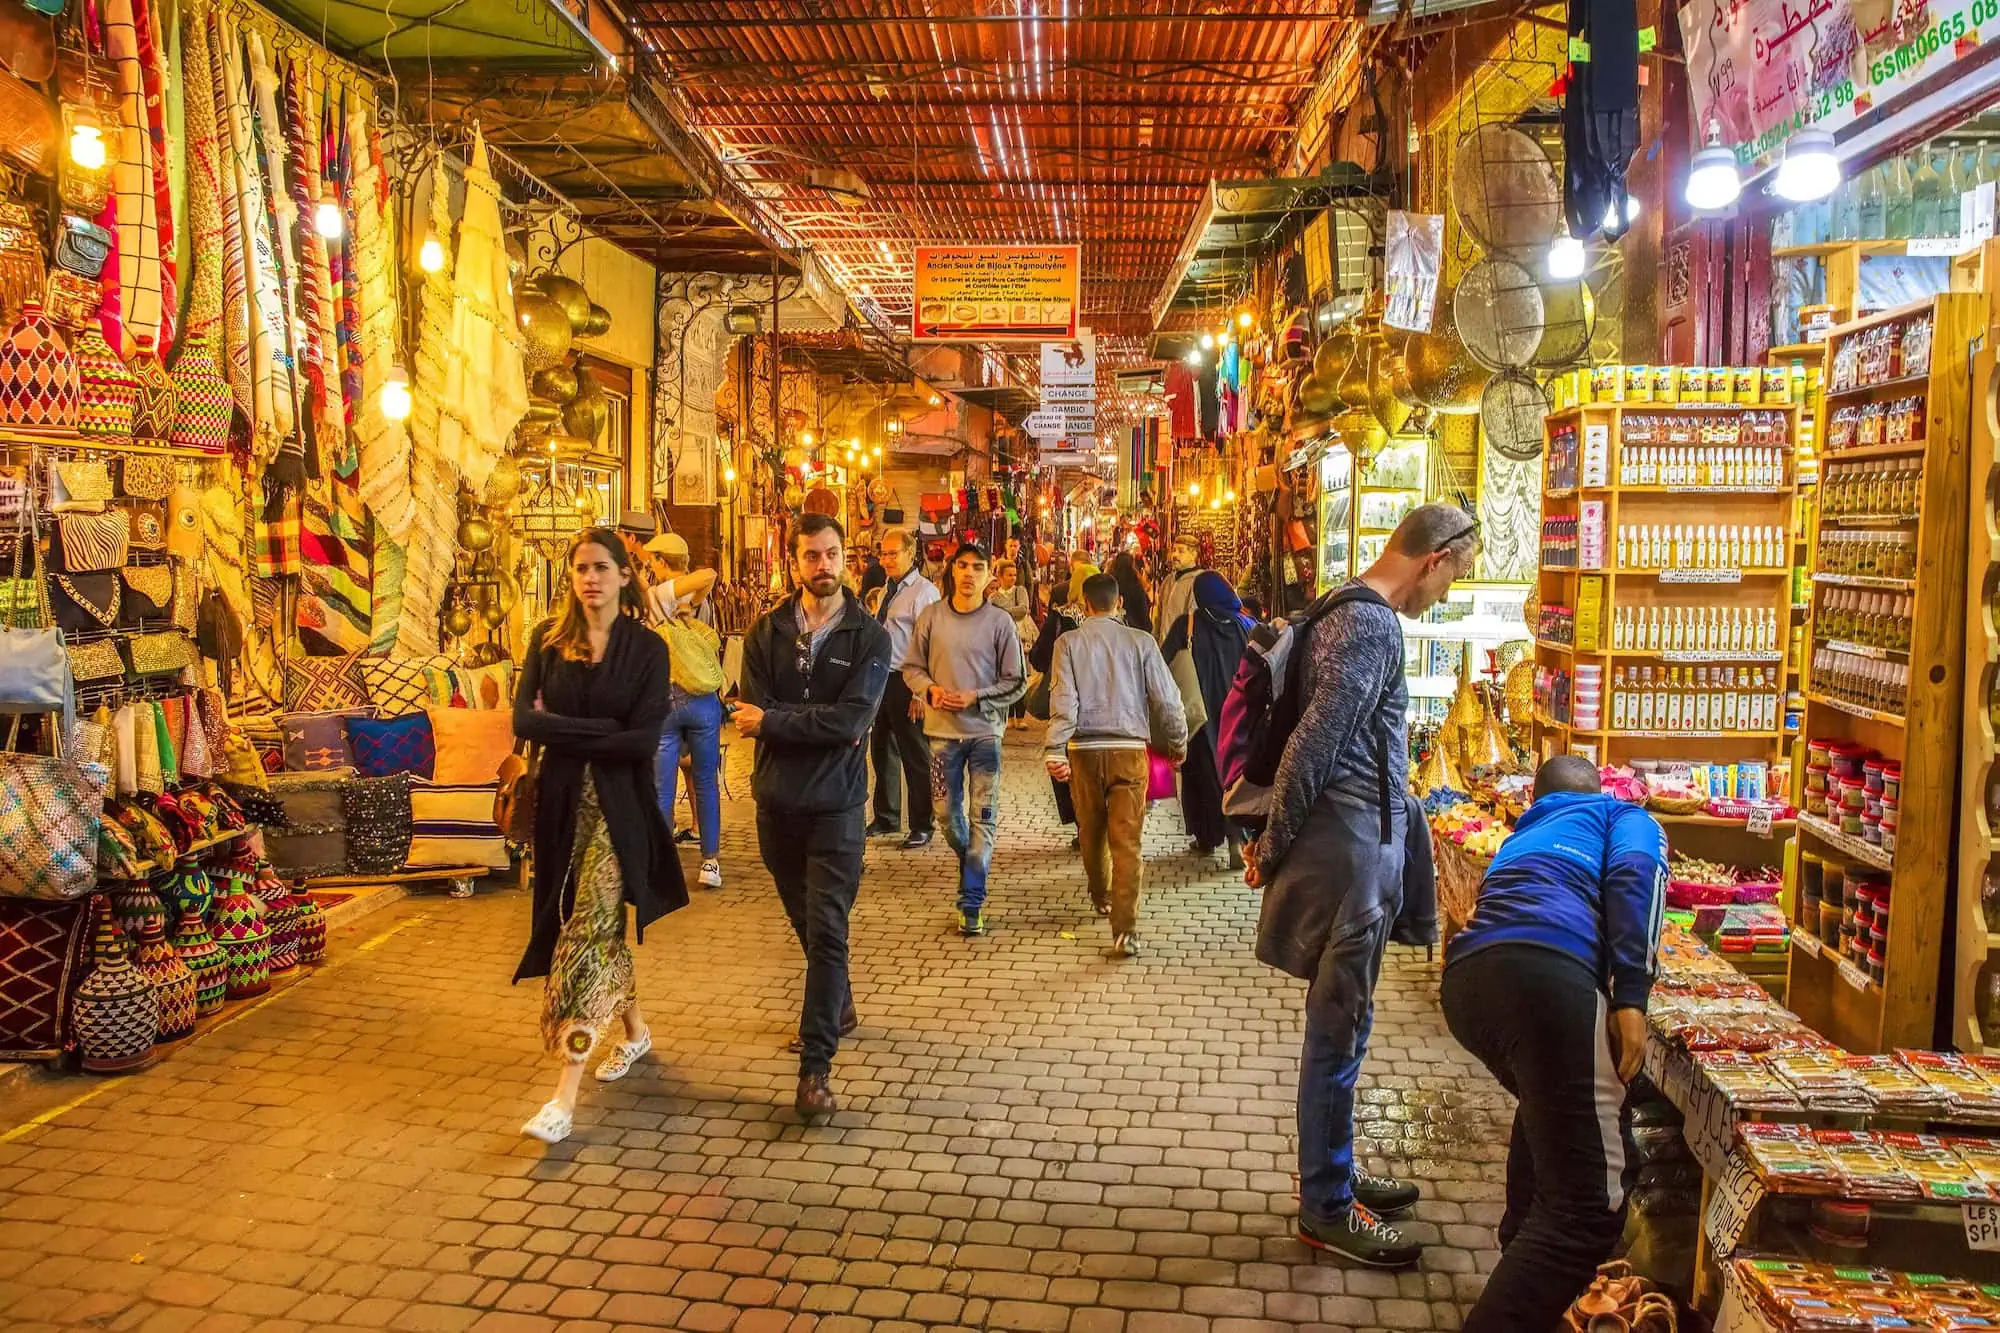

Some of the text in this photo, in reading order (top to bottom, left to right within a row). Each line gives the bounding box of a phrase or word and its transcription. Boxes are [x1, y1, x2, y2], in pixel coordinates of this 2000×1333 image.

[1871, 11, 1966, 86] GSM:0665
[1835, 80, 1855, 109] 98
[927, 262, 953, 270] Ancien
[954, 262, 973, 270] Souk
[975, 262, 986, 270] de
[987, 262, 1011, 271] Bijoux
[1048, 390, 1089, 398] CHANGE
[1033, 422, 1062, 430] CHANGE
[1968, 1205, 1998, 1223] LES
